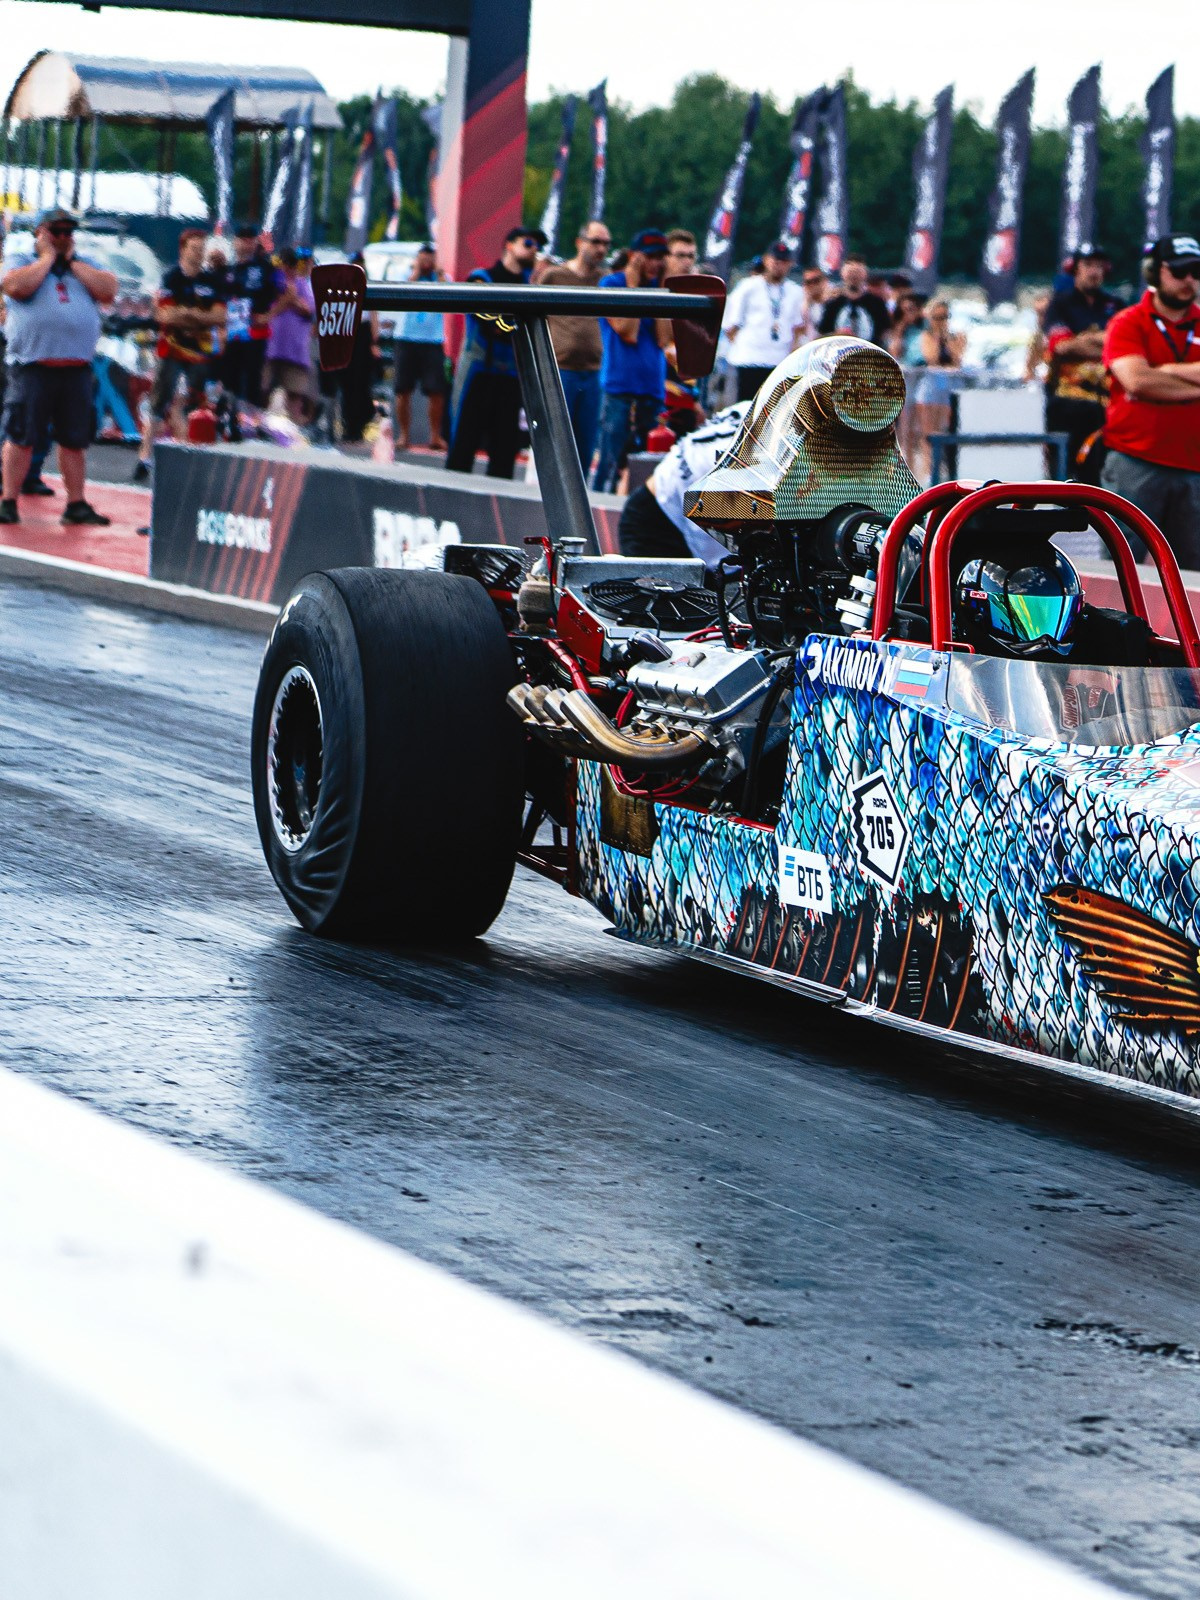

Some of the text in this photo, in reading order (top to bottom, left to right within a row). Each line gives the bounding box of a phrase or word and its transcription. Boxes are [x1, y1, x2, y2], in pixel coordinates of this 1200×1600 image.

[318, 301, 357, 336] 357M
[822, 644, 883, 692] AKIMOV
[866, 814, 895, 850] 705
[797, 864, 824, 901] ВТБ
